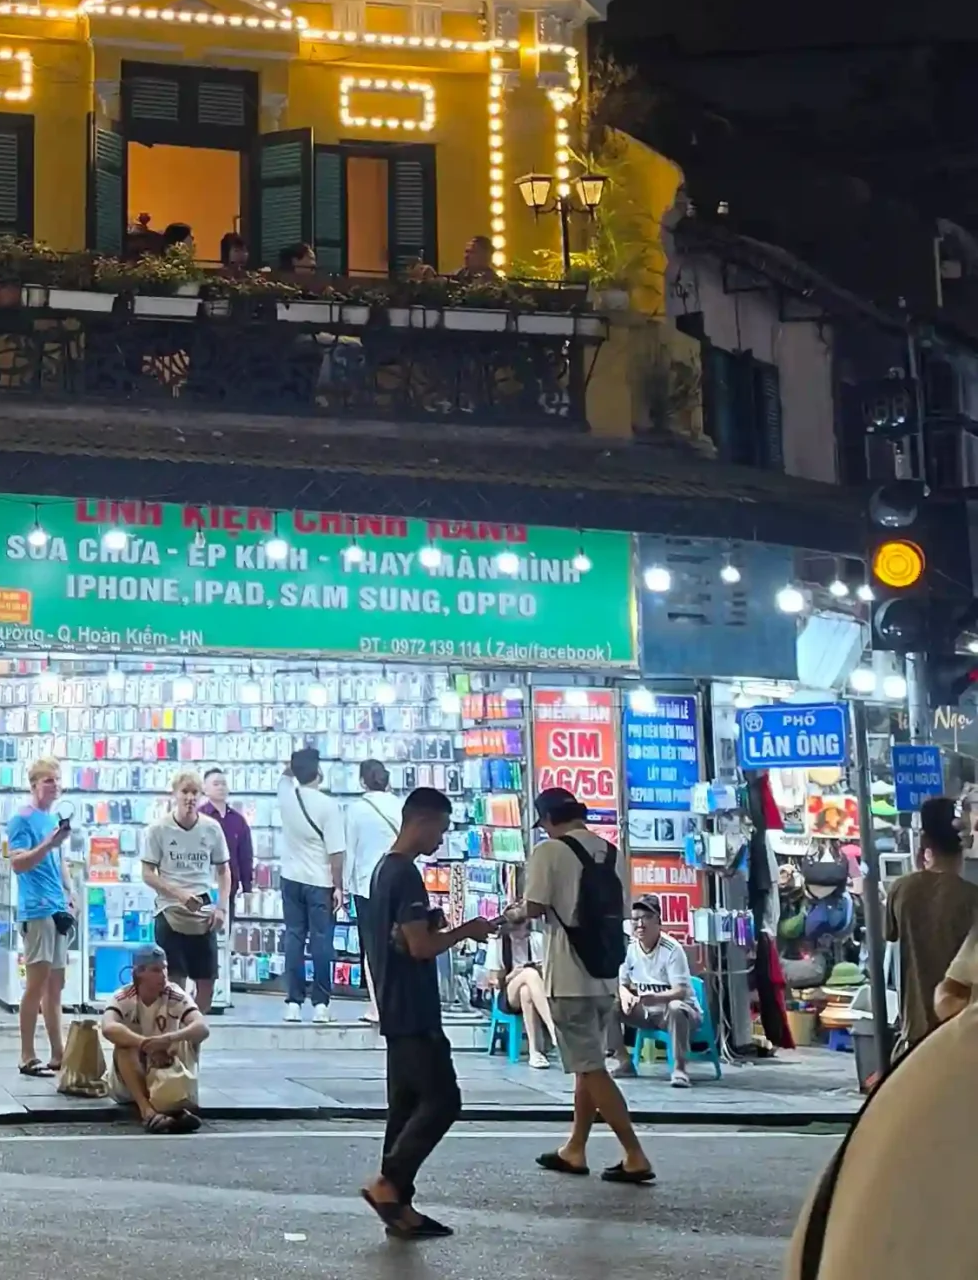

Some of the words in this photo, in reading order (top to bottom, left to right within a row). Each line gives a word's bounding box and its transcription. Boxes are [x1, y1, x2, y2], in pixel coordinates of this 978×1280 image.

[280, 582, 349, 610] SAM
[358, 588, 451, 617] SUNG,
[457, 590, 537, 617] OPPO
[78, 625, 121, 644] Hoàn
[179, 629, 204, 646] HN
[391, 637, 426, 655] 0972
[429, 638, 455, 656] 139
[459, 639, 482, 657] 114
[782, 709, 817, 726] PHỐ
[551, 730, 601, 760] SIM
[796, 729, 840, 756] ÔNG
[540, 768, 615, 798] 4G/5G
